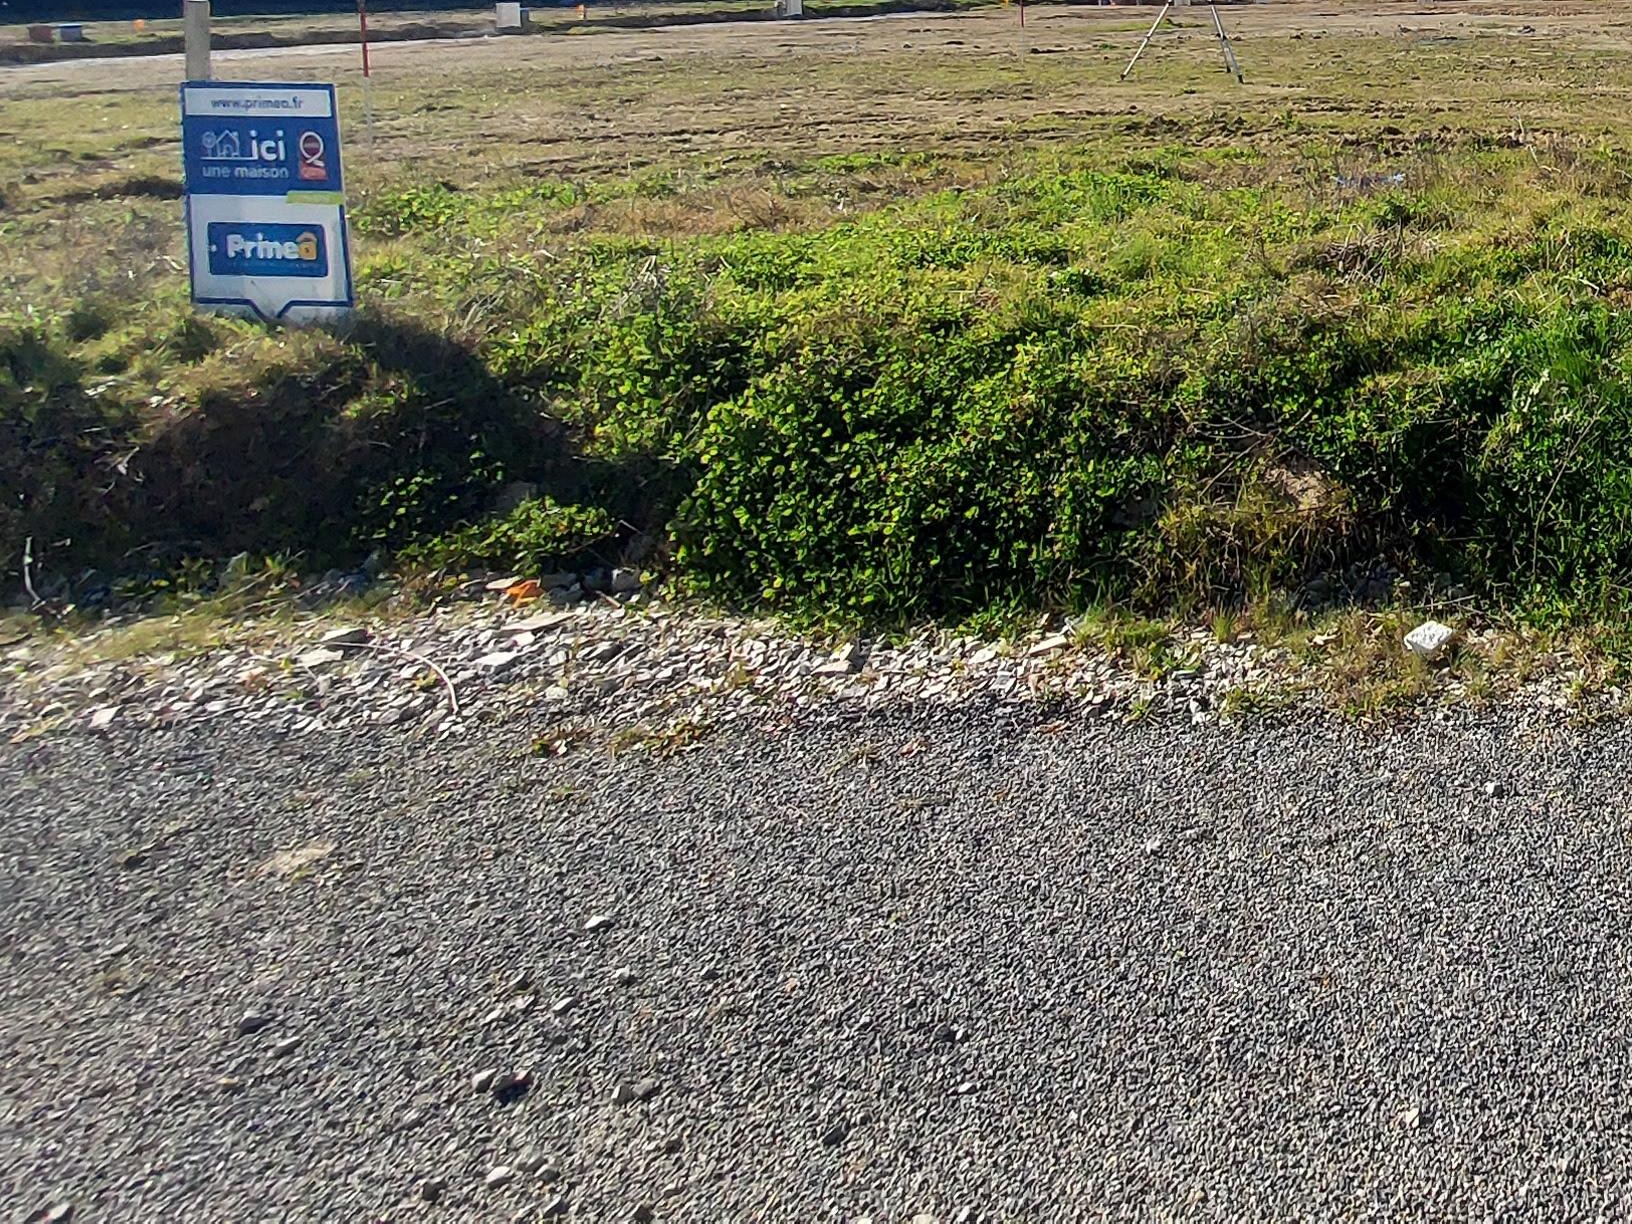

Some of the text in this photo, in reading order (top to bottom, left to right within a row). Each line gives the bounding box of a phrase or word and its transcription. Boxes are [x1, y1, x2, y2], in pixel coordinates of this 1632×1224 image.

[249, 130, 285, 161] ici
[202, 166, 231, 178] une
[235, 165, 289, 179] maison
